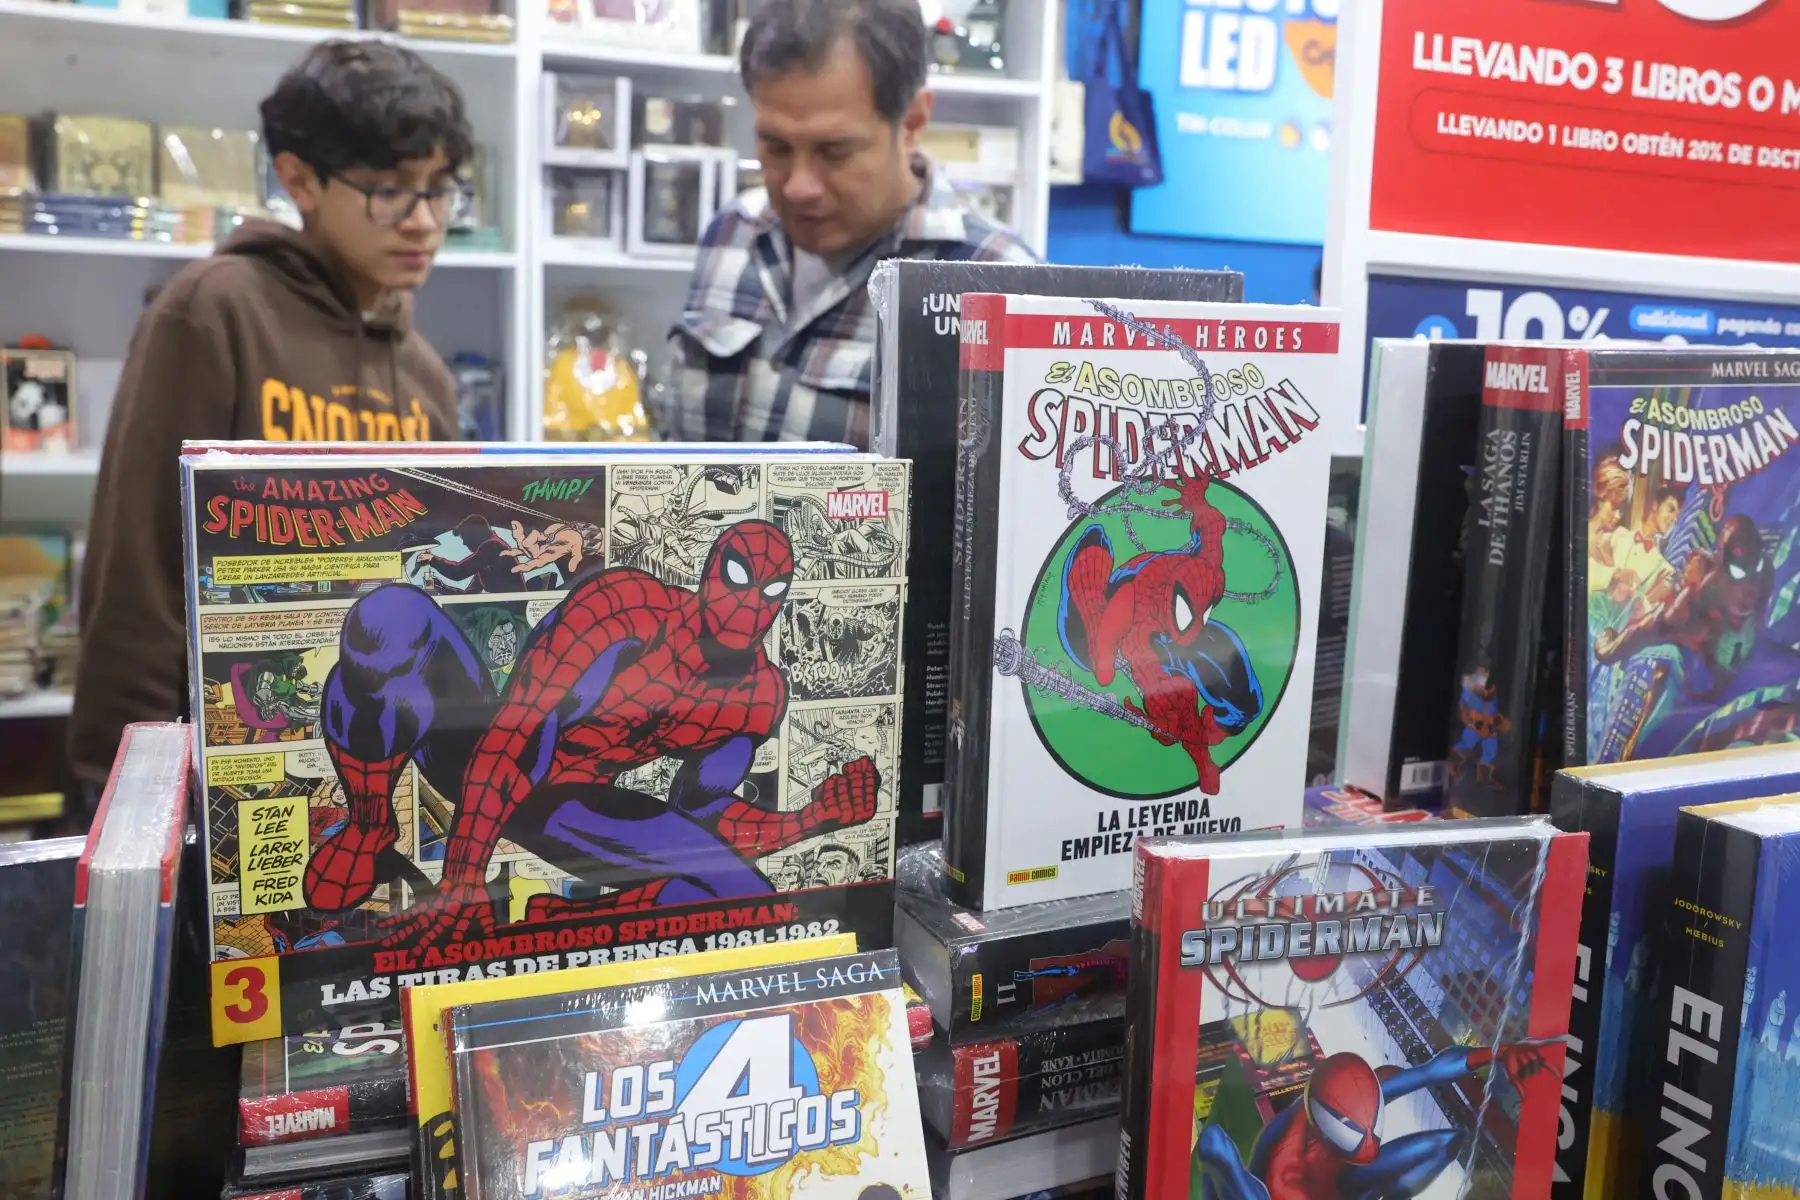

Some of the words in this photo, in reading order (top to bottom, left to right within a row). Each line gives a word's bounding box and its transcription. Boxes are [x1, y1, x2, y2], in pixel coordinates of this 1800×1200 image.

[1180, 10, 1277, 91] LED
[1413, 31, 1598, 90] LLEVANDO
[1603, 57, 1624, 94] 3
[1632, 60, 1741, 108] LIBROS
[1748, 76, 1774, 112] O
[1437, 112, 1543, 144] LLEVANDO
[1548, 124, 1557, 143] 1
[1562, 126, 1618, 151] LIBRO
[1623, 132, 1684, 157] OBTÉN
[1688, 139, 1724, 161] 20%
[1728, 145, 1752, 165] DE
[1197, 320, 1303, 351] HÉROES
[1073, 361, 1265, 409] ASOMBROSO
[1485, 362, 1549, 393] MARVEL
[1712, 362, 1769, 378] MARVEL
[1565, 370, 1581, 420] MARVEL
[1018, 379, 1321, 481] SPIDERMAN
[1647, 395, 1764, 431] ASOMBROSO
[1481, 428, 1500, 493] SAGA
[1518, 432, 1531, 487] STARLIN
[1618, 407, 1800, 487] SPIDERMAN
[262, 473, 390, 501] AMAZING
[522, 477, 594, 503] THWIP!
[1492, 430, 1517, 528] THANOS
[203, 488, 428, 547] SPIDER-MAN
[828, 493, 886, 518] MARVEL
[966, 473, 976, 533] EMPIEZA
[1478, 497, 1494, 527] LA
[1514, 489, 1525, 512] JIM
[1488, 533, 1506, 566] DE
[217, 573, 242, 581] CREAR
[255, 571, 305, 580] LANZARREDES
[963, 537, 973, 600] LEYENDA
[236, 634, 260, 642] MISMO
[251, 804, 295, 822] STAN
[254, 820, 288, 834] LEE
[1098, 809, 1121, 833] LA
[1128, 798, 1211, 829] LEYENDA
[247, 853, 304, 872] LIEBER
[249, 839, 304, 858] LARRY
[1061, 830, 1145, 861] EMPIEZ
[252, 875, 299, 891] FRED
[255, 891, 294, 906] KIDA
[1202, 885, 1436, 921] ULTIMATE
[1673, 897, 1743, 930] JODOROWSKY
[373, 950, 415, 974] EL
[421, 926, 613, 968] ASOMBROSO
[618, 902, 800, 943] SPIDERMAN:
[1180, 911, 1445, 967] SPIDERMAN
[321, 976, 391, 1007] LAS
[512, 954, 560, 975] DE
[565, 937, 699, 969] PRENSA
[704, 919, 841, 952] 1981-1982
[224, 966, 269, 1023] 3
[696, 970, 807, 1007] MARVEL
[816, 961, 885, 988] SAGA
[1666, 984, 1724, 1065] EL
[583, 1059, 677, 1126] LOS
[675, 1015, 806, 1125] 4
[1041, 1056, 1073, 1072] KANE
[1041, 1070, 1083, 1088] CLON
[968, 1051, 1000, 1142] MARVEL
[265, 1106, 336, 1138] MARVEL
[523, 1088, 862, 1198] FANTÁSTICOS
[652, 1175, 721, 1200] HICKMAN
